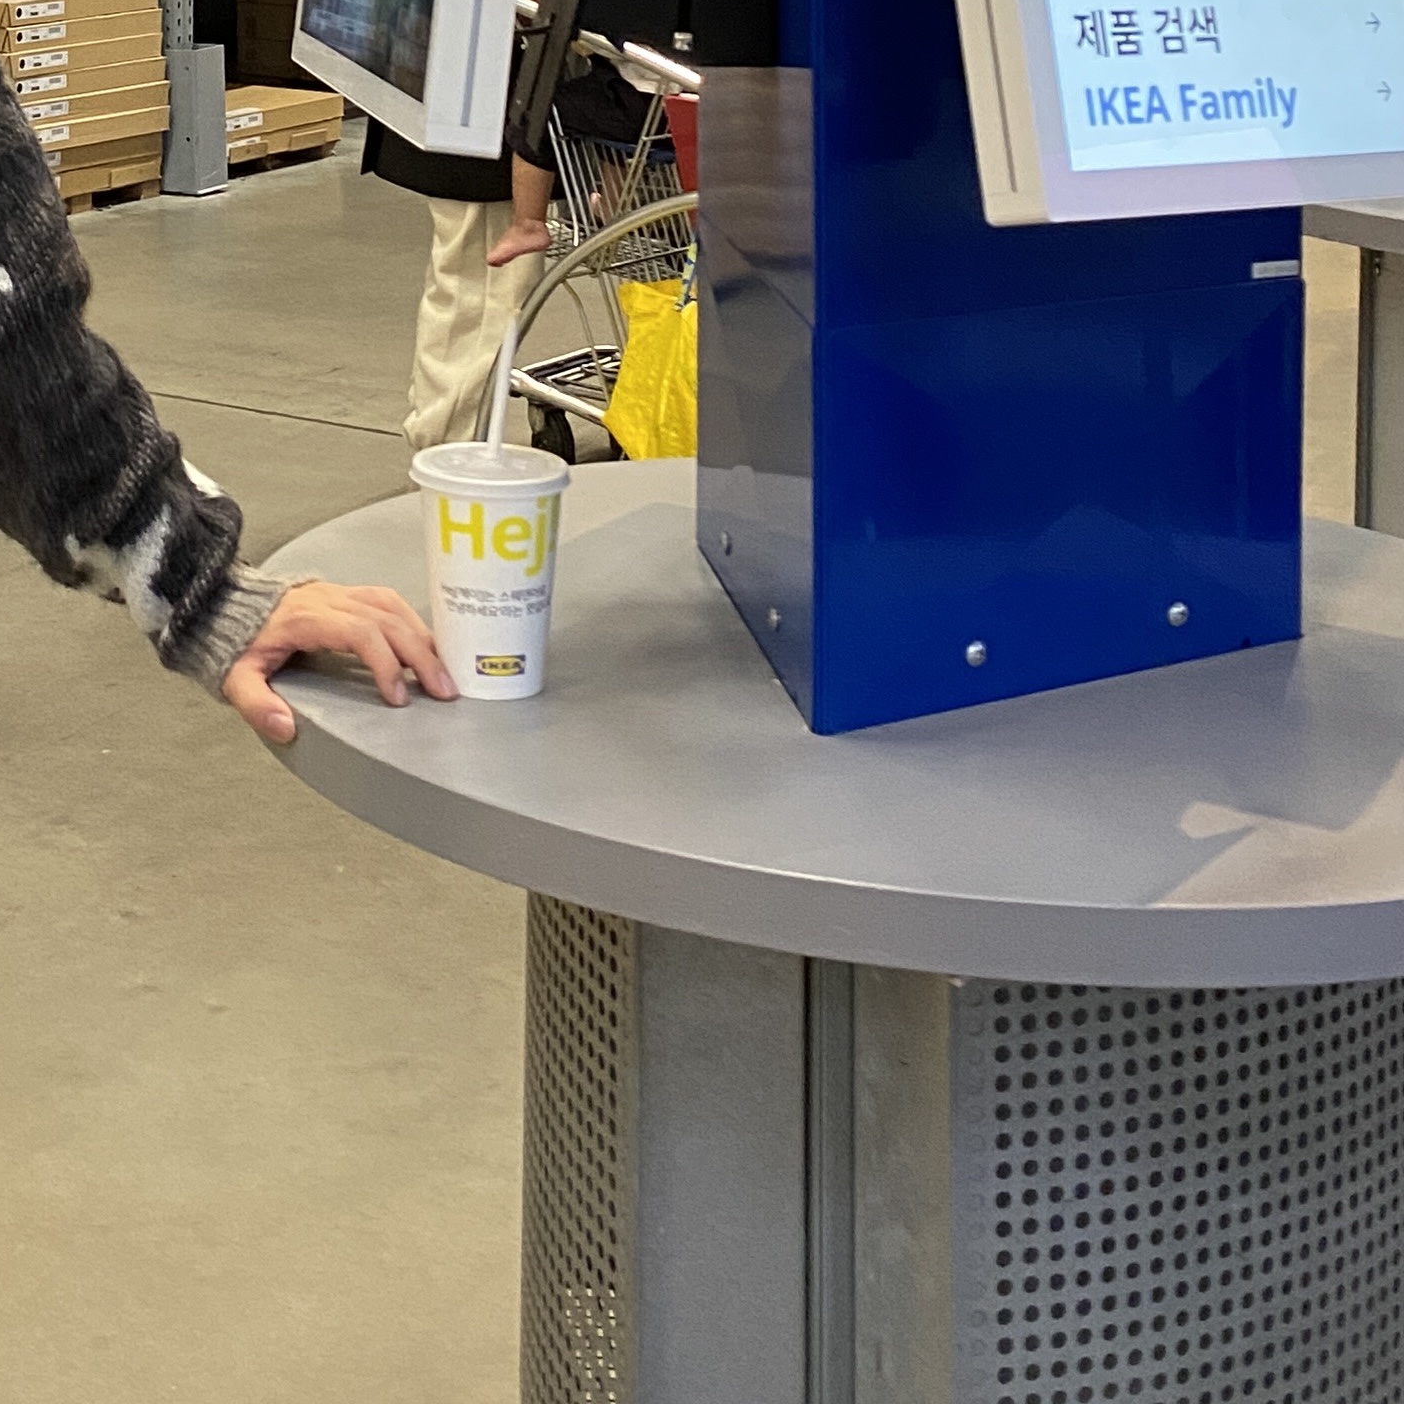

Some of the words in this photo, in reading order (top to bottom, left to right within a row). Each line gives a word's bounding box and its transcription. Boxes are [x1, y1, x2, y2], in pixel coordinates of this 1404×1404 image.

[1074, 9, 1144, 58] 제품
[1153, 5, 1222, 55] 검색
[1085, 84, 1172, 127] IKEA
[1179, 77, 1298, 129] Family
[480, 658, 523, 671] IKEA
